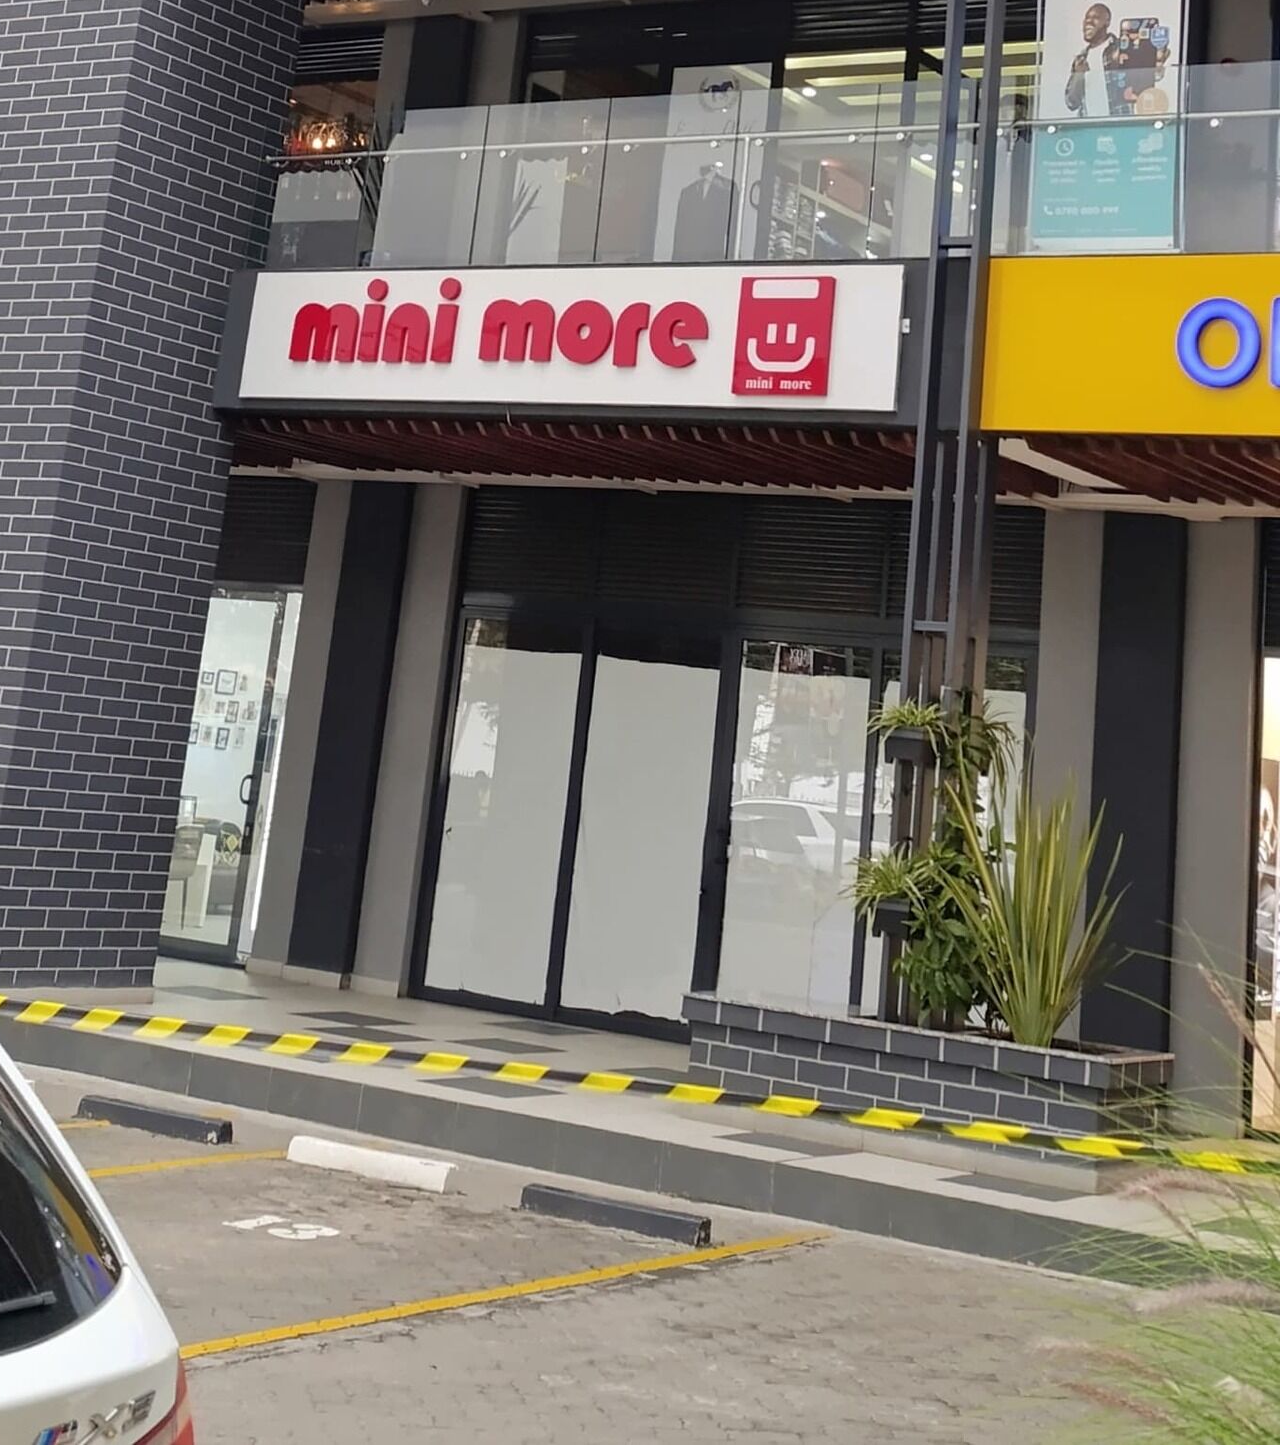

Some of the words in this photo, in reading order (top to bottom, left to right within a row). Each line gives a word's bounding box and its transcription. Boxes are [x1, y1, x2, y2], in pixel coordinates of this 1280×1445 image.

[288, 277, 463, 363] mini
[478, 298, 710, 369] more
[745, 375, 772, 390] mini
[779, 376, 812, 390] more
